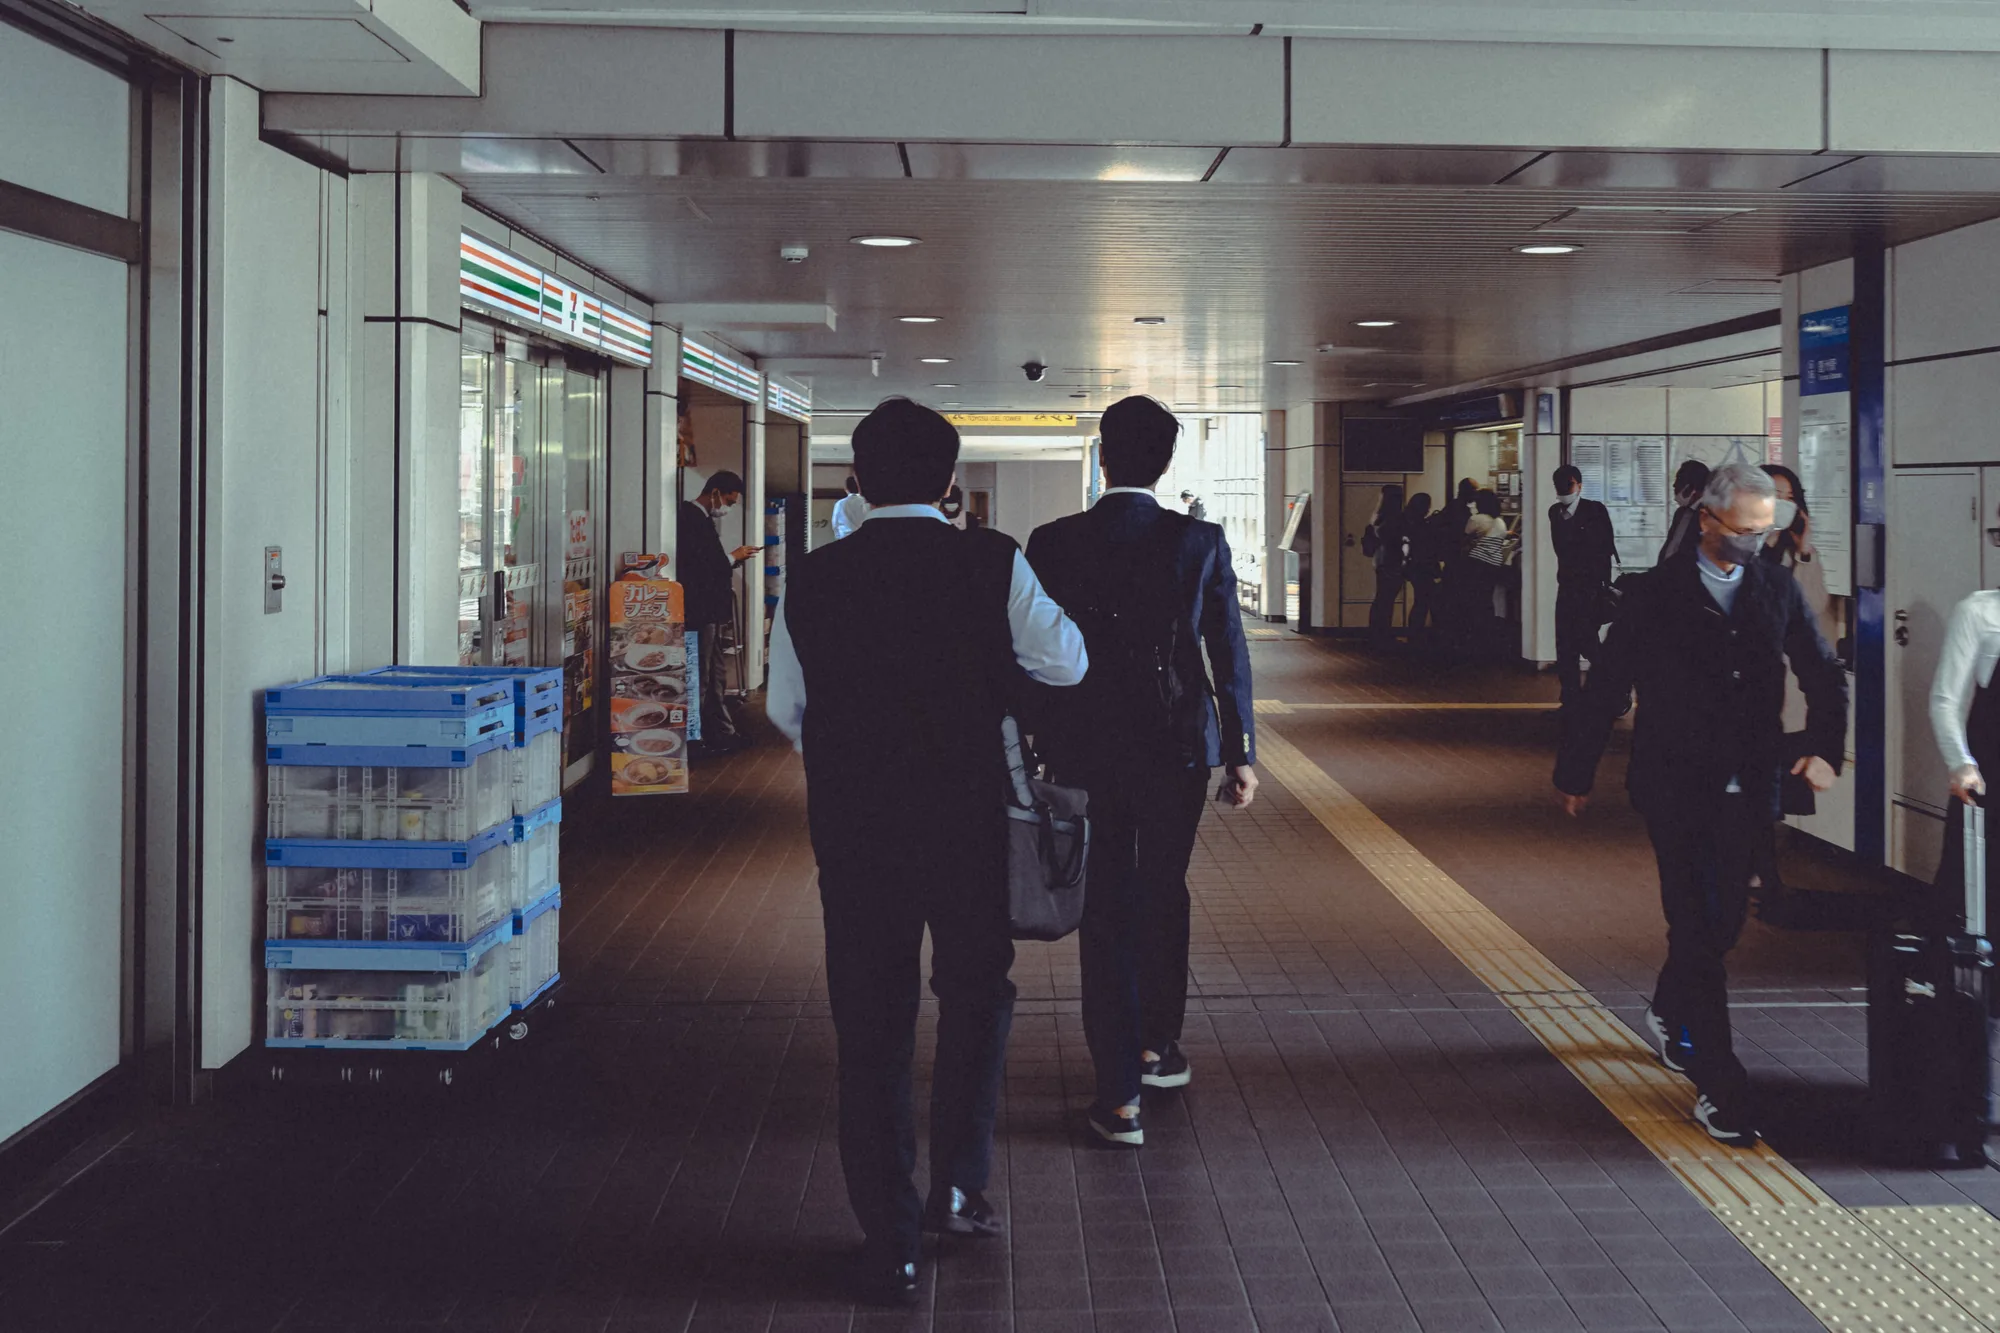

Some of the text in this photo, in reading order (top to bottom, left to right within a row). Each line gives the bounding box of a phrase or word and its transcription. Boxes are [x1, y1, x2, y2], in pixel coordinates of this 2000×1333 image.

[625, 585, 669, 602] カレー
[624, 602, 670, 618] フェス
